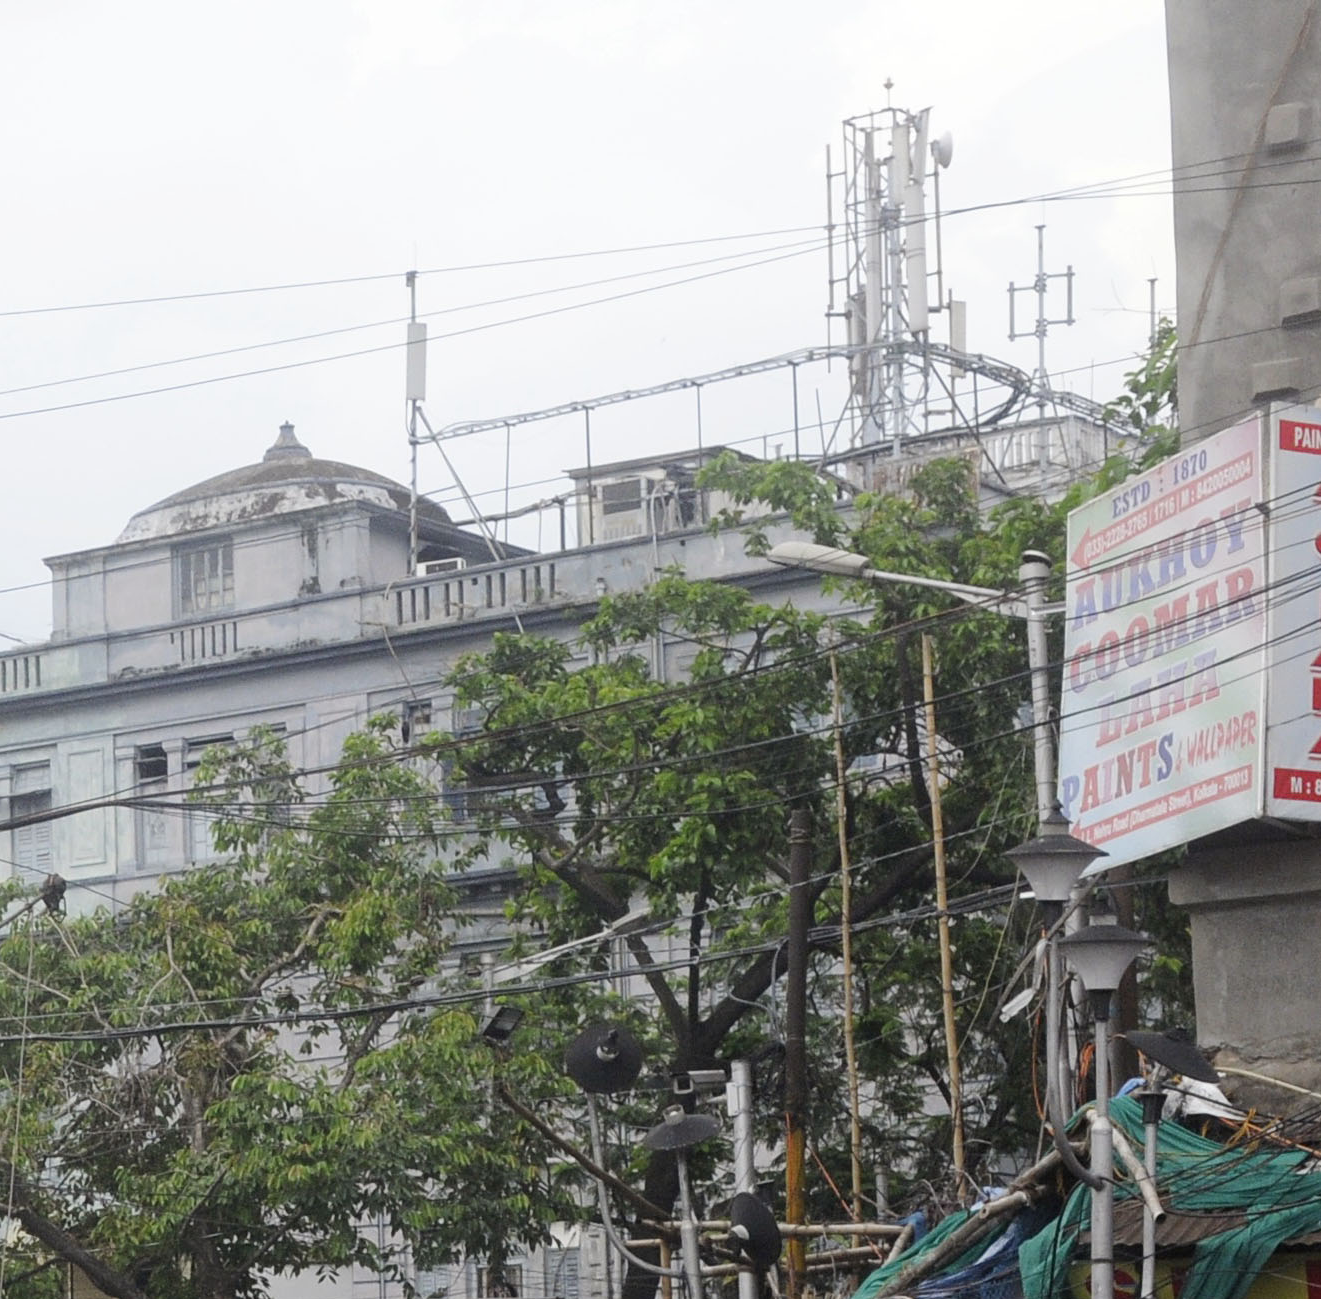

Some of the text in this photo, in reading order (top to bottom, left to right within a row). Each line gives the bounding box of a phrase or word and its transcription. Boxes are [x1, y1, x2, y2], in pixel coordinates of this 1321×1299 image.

[1112, 480, 1150, 519] ESTD
[1172, 450, 1207, 485] 1870
[1073, 496, 1251, 632] AUKHOY
[1070, 568, 1255, 693] COOMAR
[1096, 648, 1220, 748] LAHA
[1062, 732, 1173, 818] PAINTS
[1187, 711, 1256, 767] WALLPAPER
[1290, 776, 1302, 794] M
